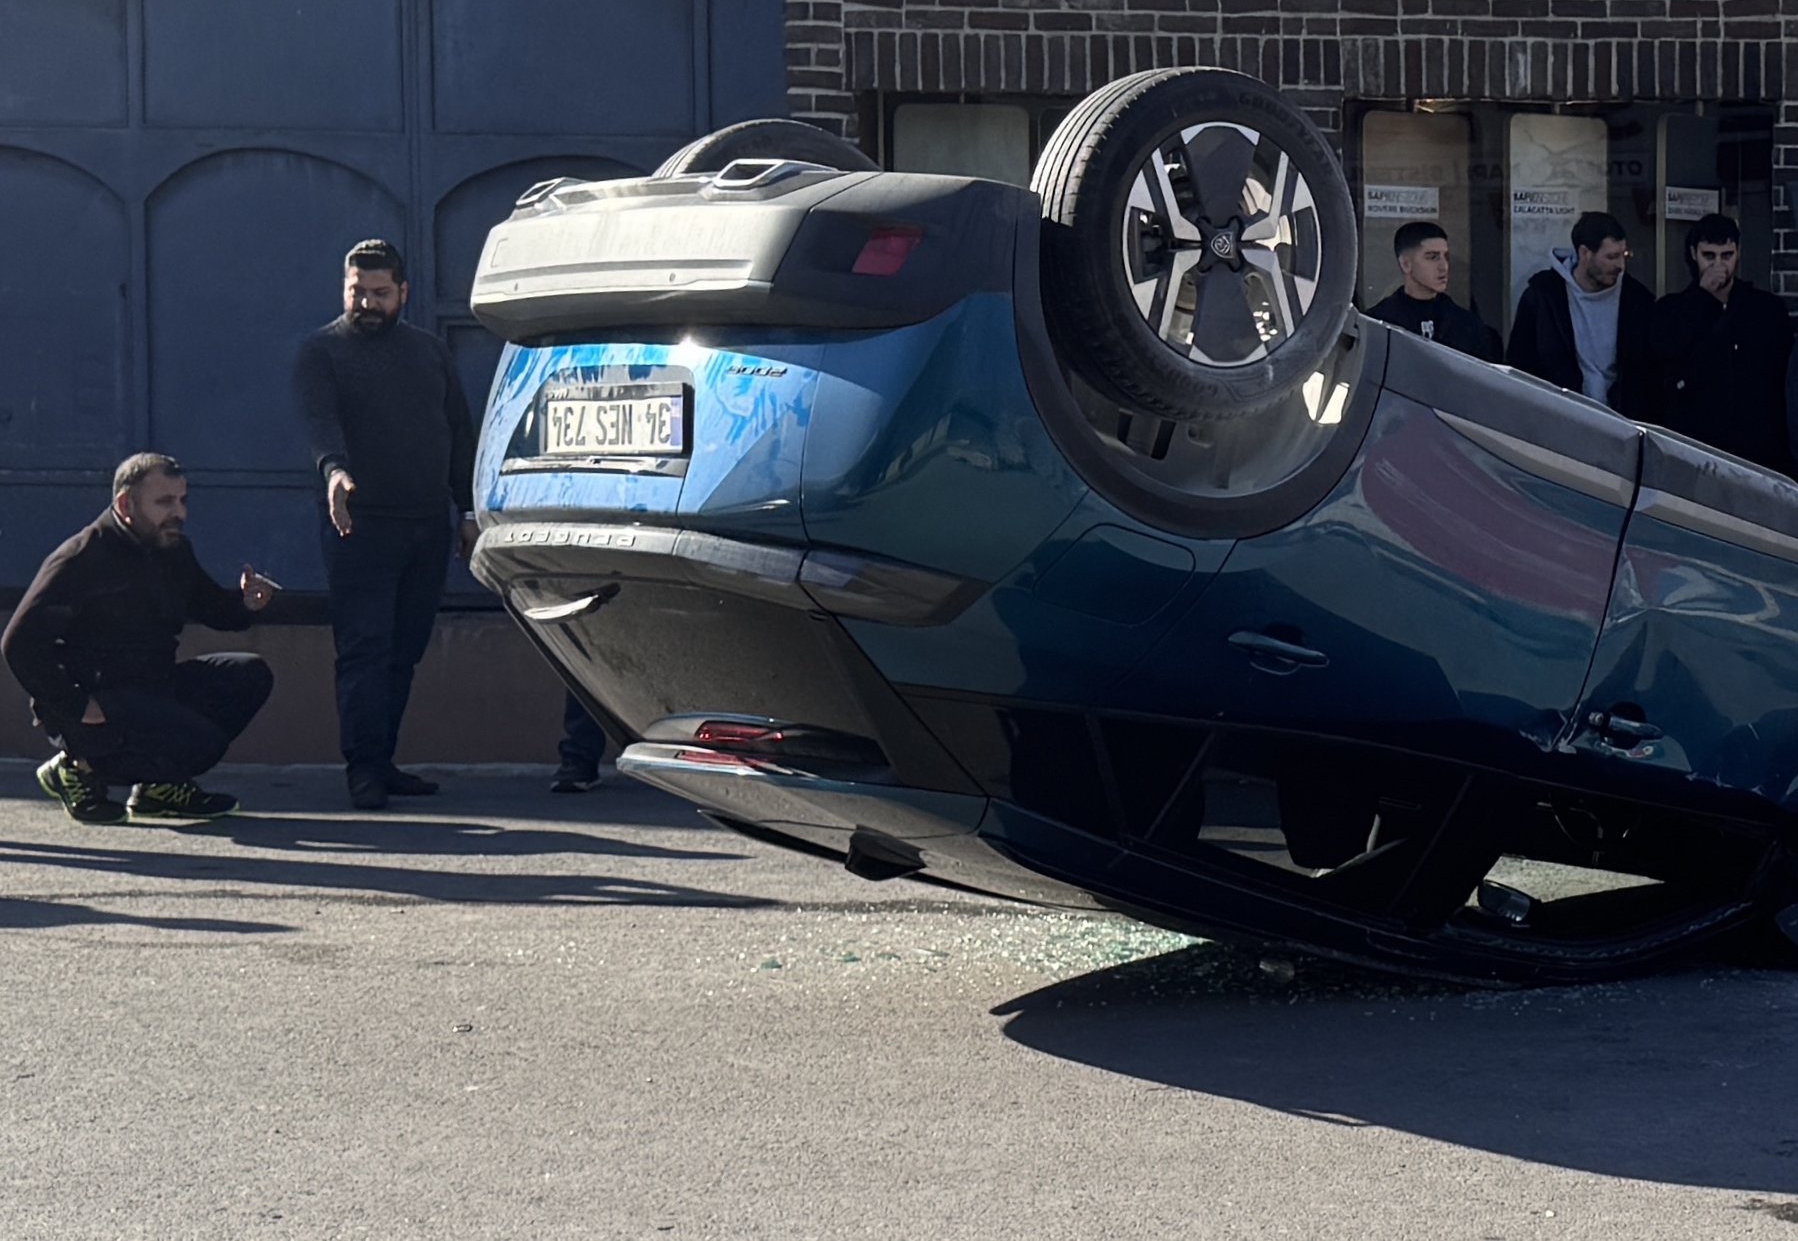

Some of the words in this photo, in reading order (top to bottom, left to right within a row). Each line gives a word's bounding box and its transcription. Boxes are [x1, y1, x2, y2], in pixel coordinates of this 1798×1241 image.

[551, 405, 587, 447] 734
[594, 403, 633, 447] NES
[646, 402, 672, 445] 34
[503, 531, 637, 549] PEUGEOT
